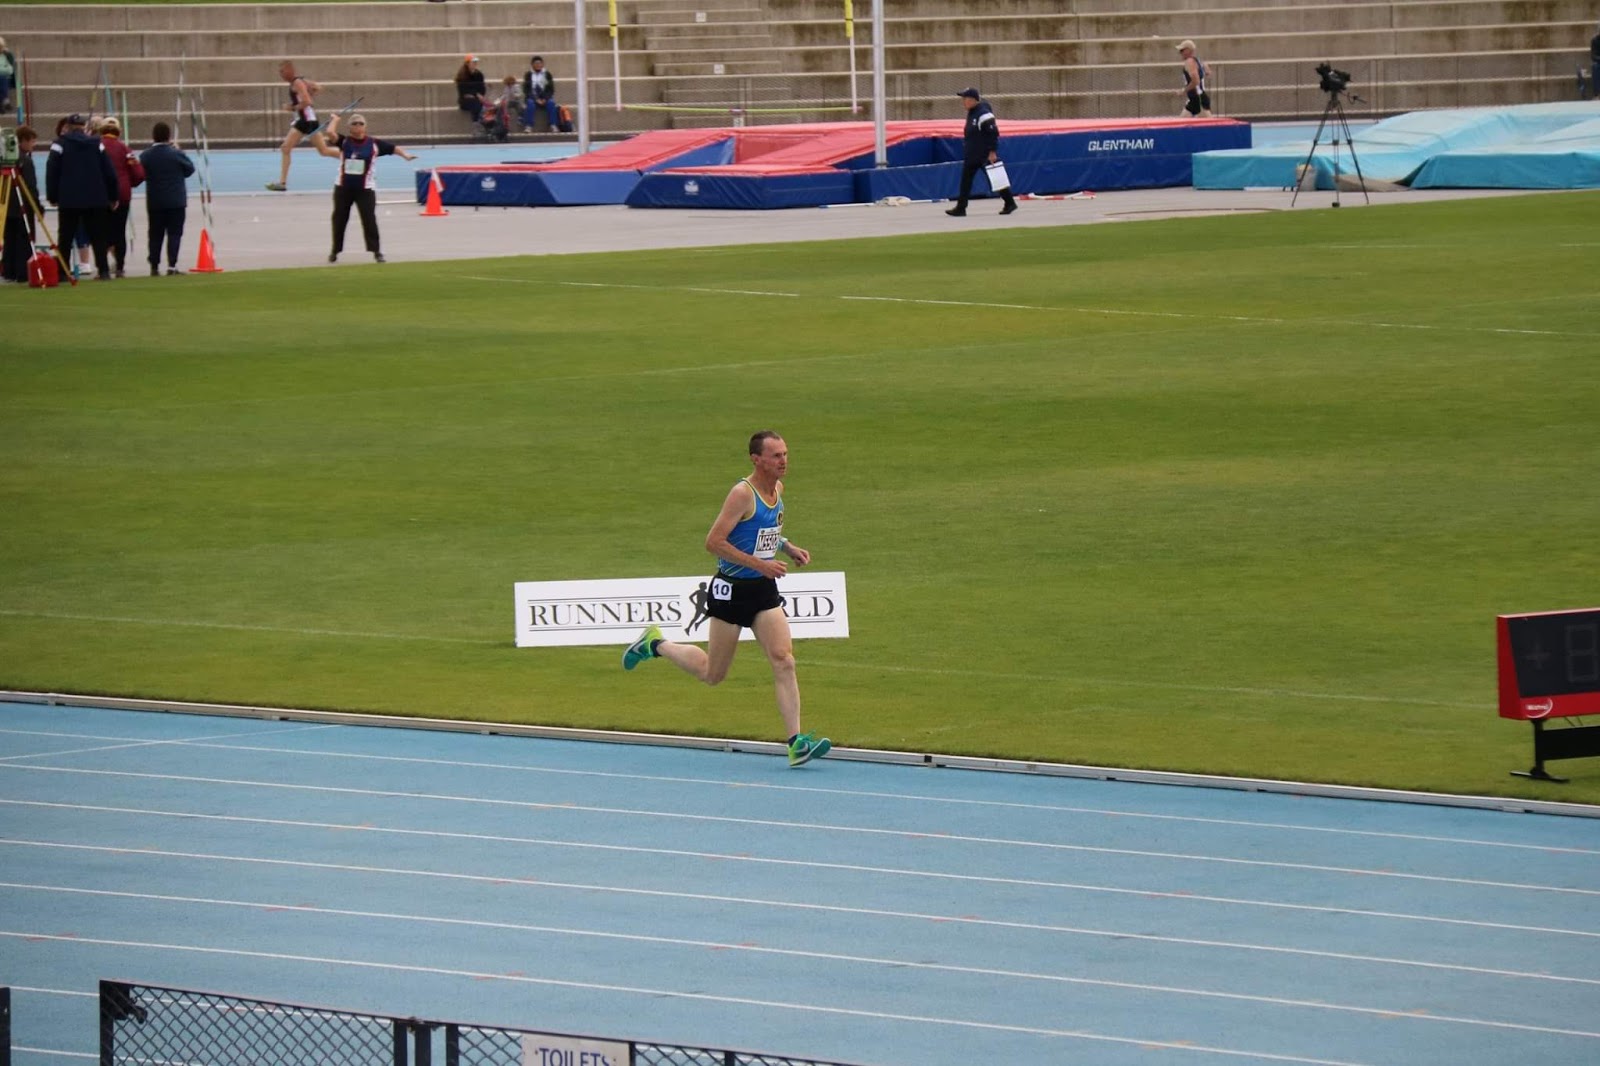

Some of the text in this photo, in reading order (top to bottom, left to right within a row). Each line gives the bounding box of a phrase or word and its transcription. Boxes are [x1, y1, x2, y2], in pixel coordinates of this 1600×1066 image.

[1088, 138, 1154, 151] GLENTHAM
[714, 583, 730, 596] 10
[529, 600, 682, 626] RUNNERS
